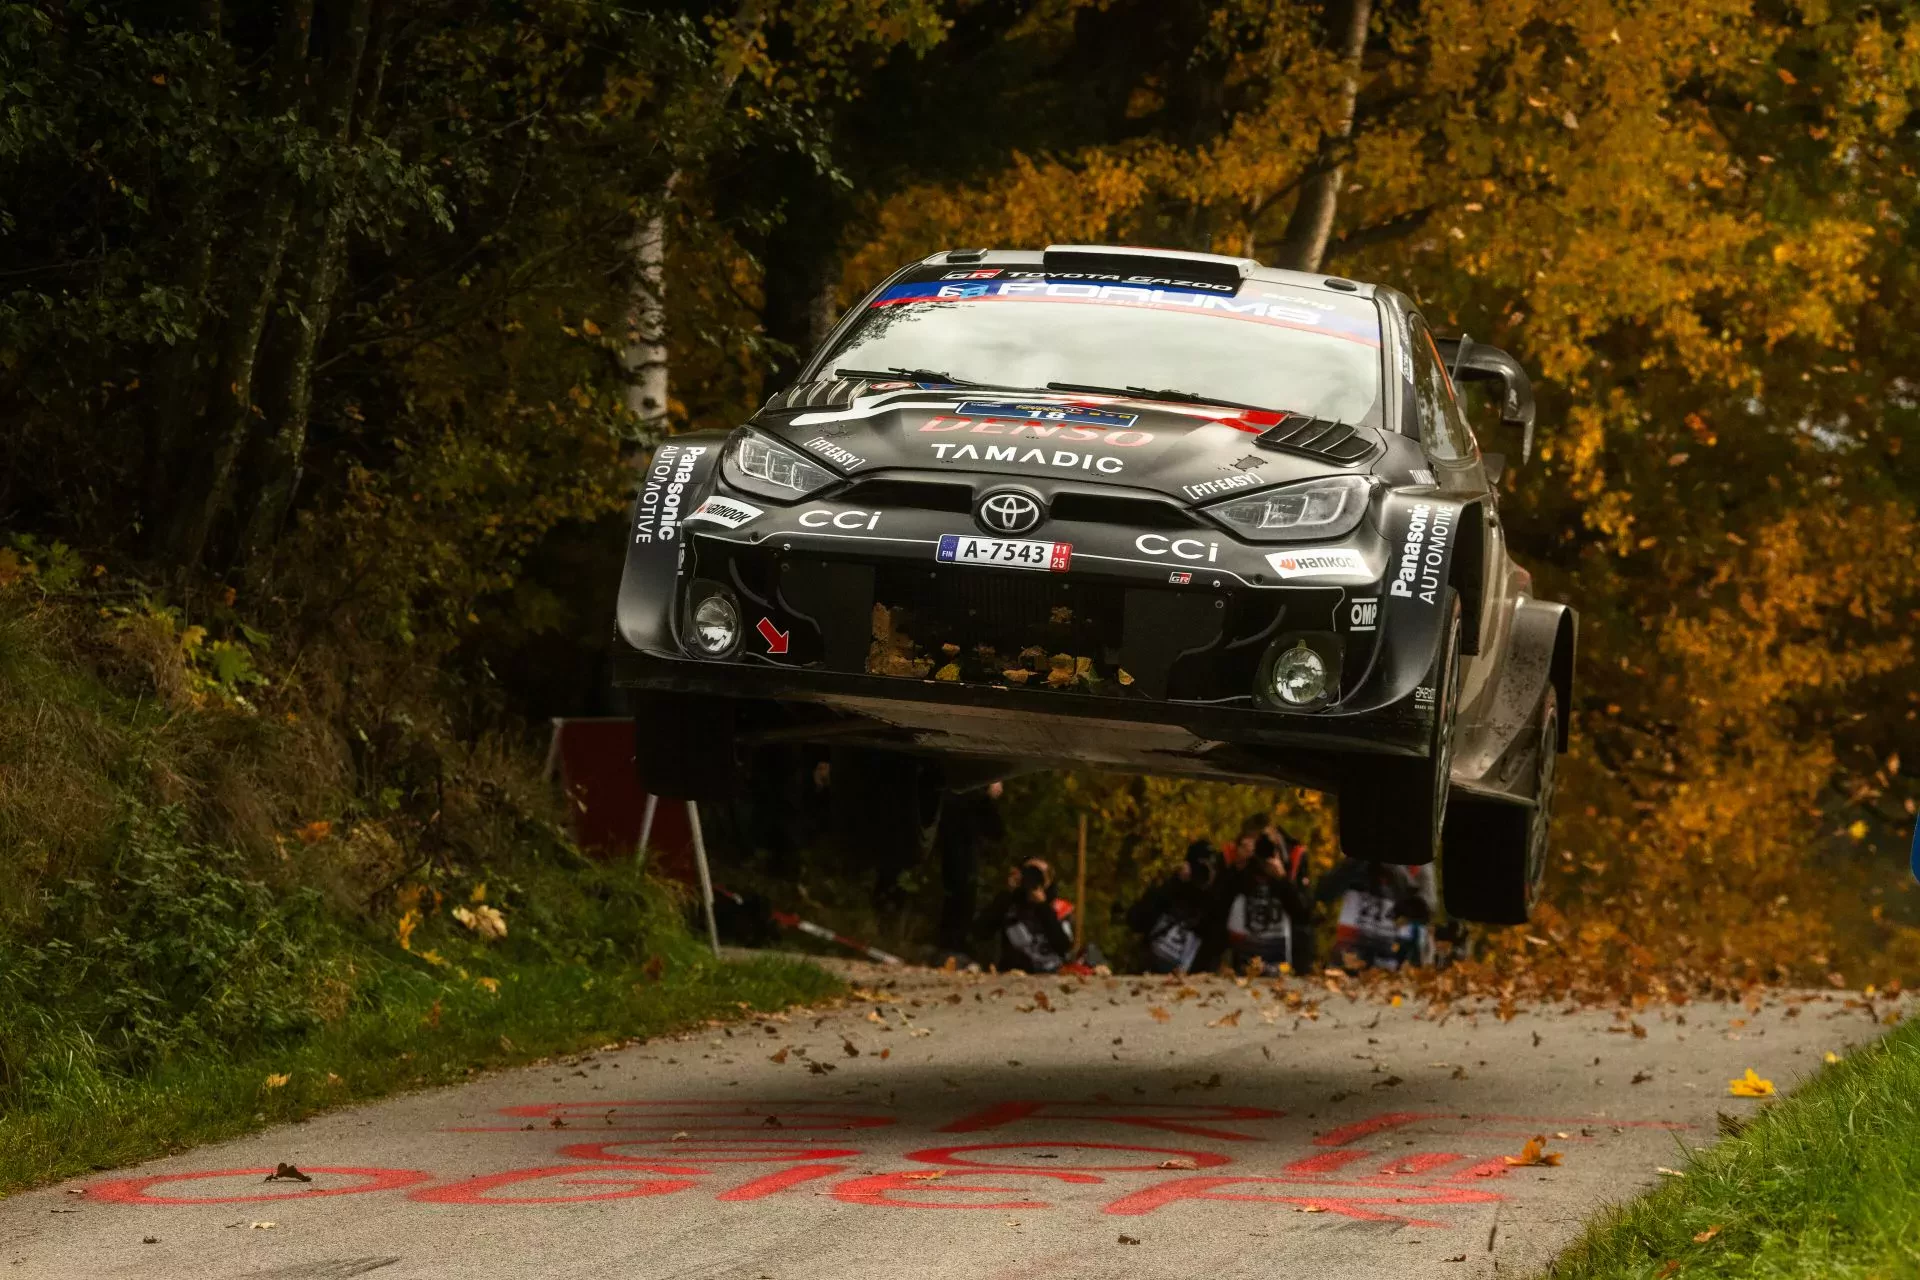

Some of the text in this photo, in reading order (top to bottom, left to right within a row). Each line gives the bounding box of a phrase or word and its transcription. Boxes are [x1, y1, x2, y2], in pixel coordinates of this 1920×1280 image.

[1008, 271, 1120, 281] TOYOTA
[1128, 276, 1234, 291] GAZOO
[997, 281, 1322, 326] FORUM8
[1027, 410, 1067, 420] 18
[917, 415, 1155, 447] DENSO
[931, 443, 1124, 473] TAMADIC
[635, 445, 679, 544] AUTOMOTIVE
[658, 446, 707, 541] Panasonic
[941, 550, 953, 558] FIN
[963, 540, 1045, 564] A-7543
[1052, 557, 1065, 568] 25
[1055, 545, 1067, 554] 11
[1390, 504, 1432, 598] Panasonic
[1419, 505, 1454, 605] AUTOMOTIVE
[1350, 603, 1378, 625] OMP
[81, 1164, 1505, 1228] OGIER
